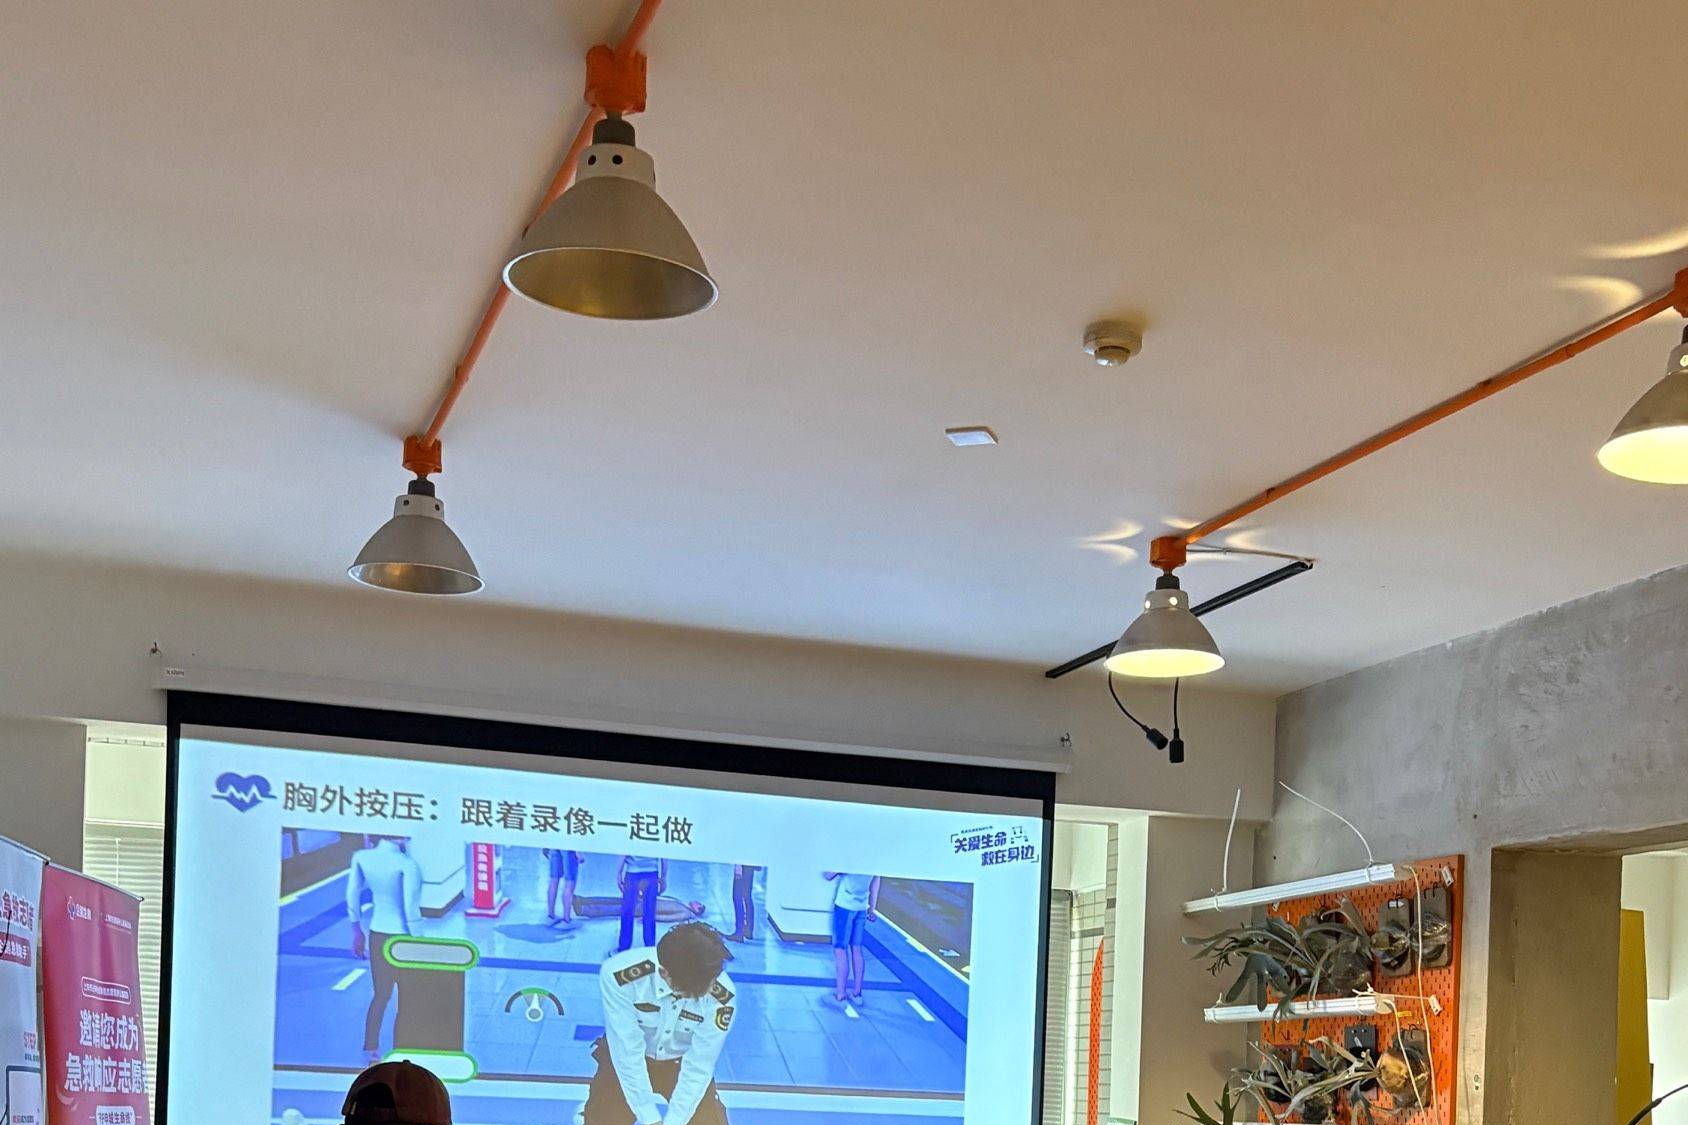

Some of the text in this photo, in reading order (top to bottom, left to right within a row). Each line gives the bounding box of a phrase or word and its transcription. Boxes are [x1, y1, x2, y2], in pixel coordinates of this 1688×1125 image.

[80, 1008, 139, 1051] 邀请您成为
